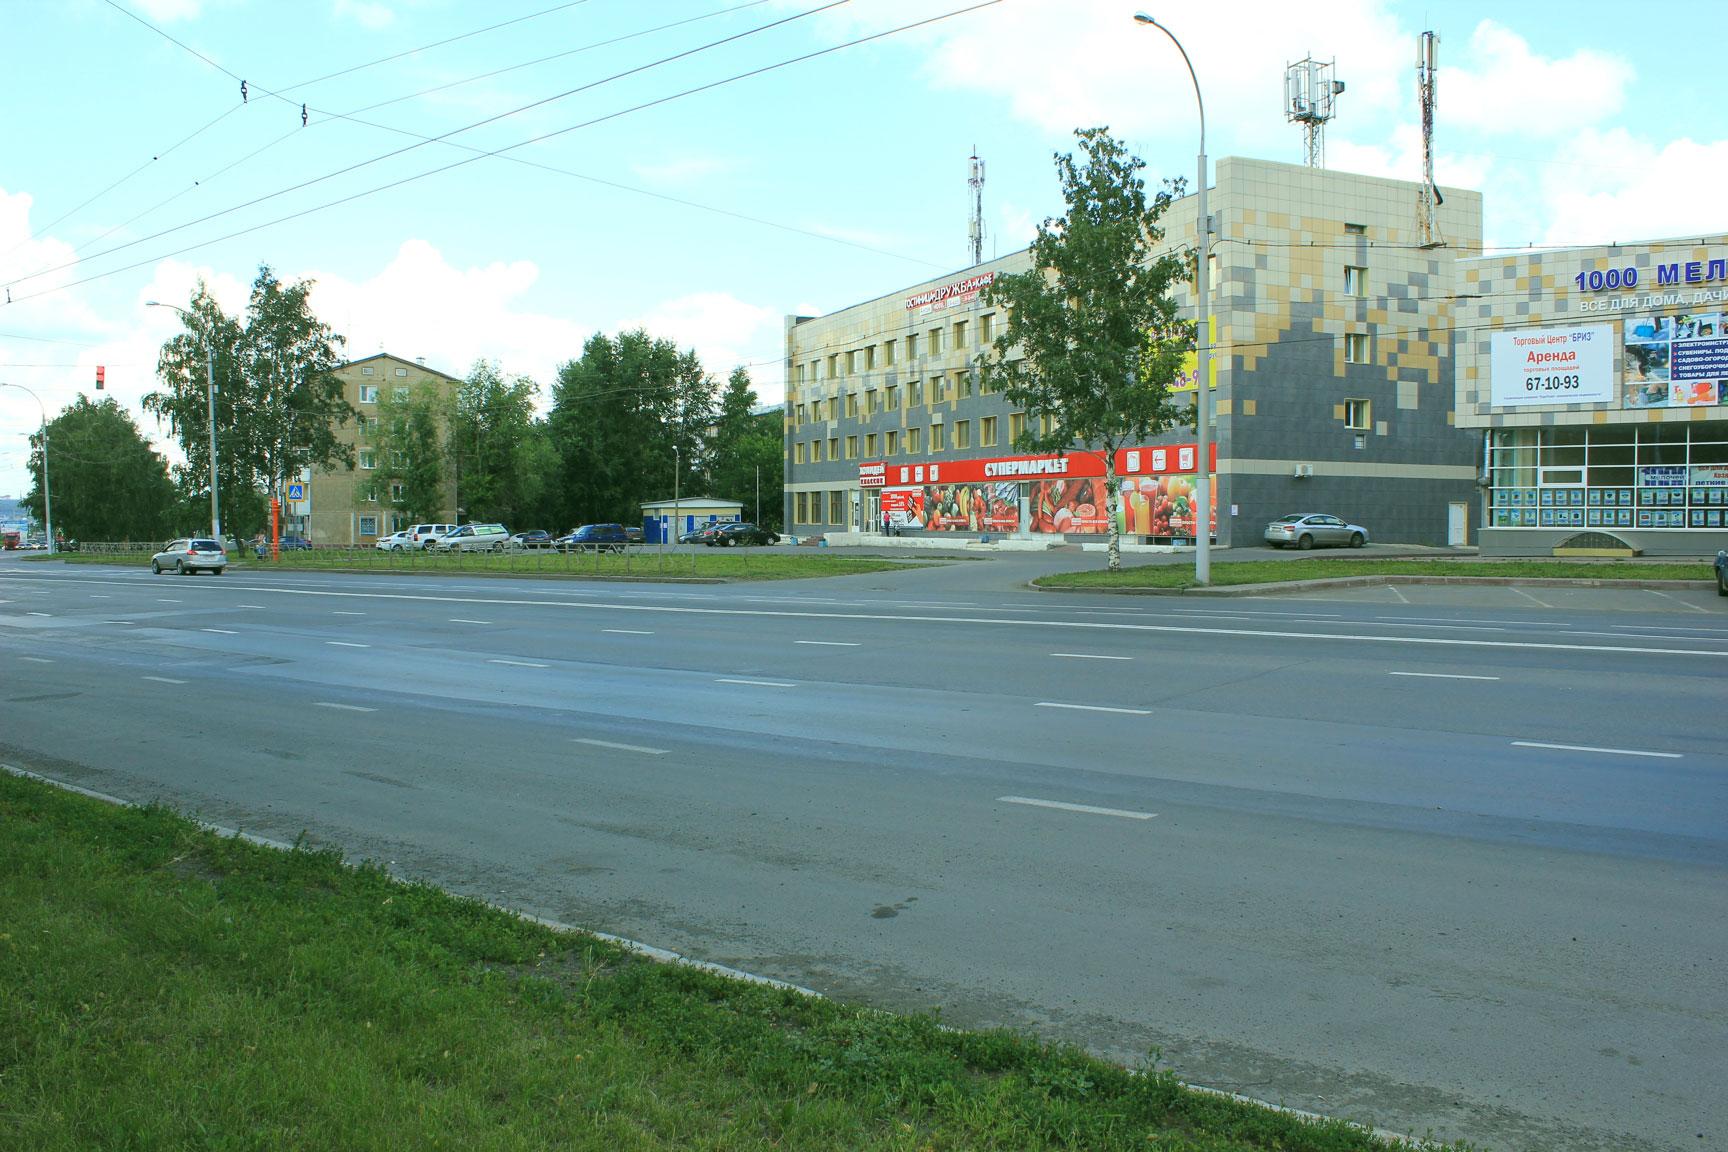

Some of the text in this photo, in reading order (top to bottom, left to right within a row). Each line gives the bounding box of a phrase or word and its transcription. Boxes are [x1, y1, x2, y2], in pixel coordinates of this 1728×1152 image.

[1575, 258, 1727, 292] 1000 МЕЛ
[1580, 301, 1607, 313] ВСЕ
[1610, 297, 1639, 311] ДЛЯ
[1642, 294, 1689, 309] ДОМА,
[1513, 335, 1545, 347] Торговый
[1547, 335, 1568, 346] Центр
[1527, 350, 1576, 365] Аренда
[1526, 375, 1580, 392] 67-10-93
[984, 457, 1069, 477] СУПЕРМАРКЕТ
